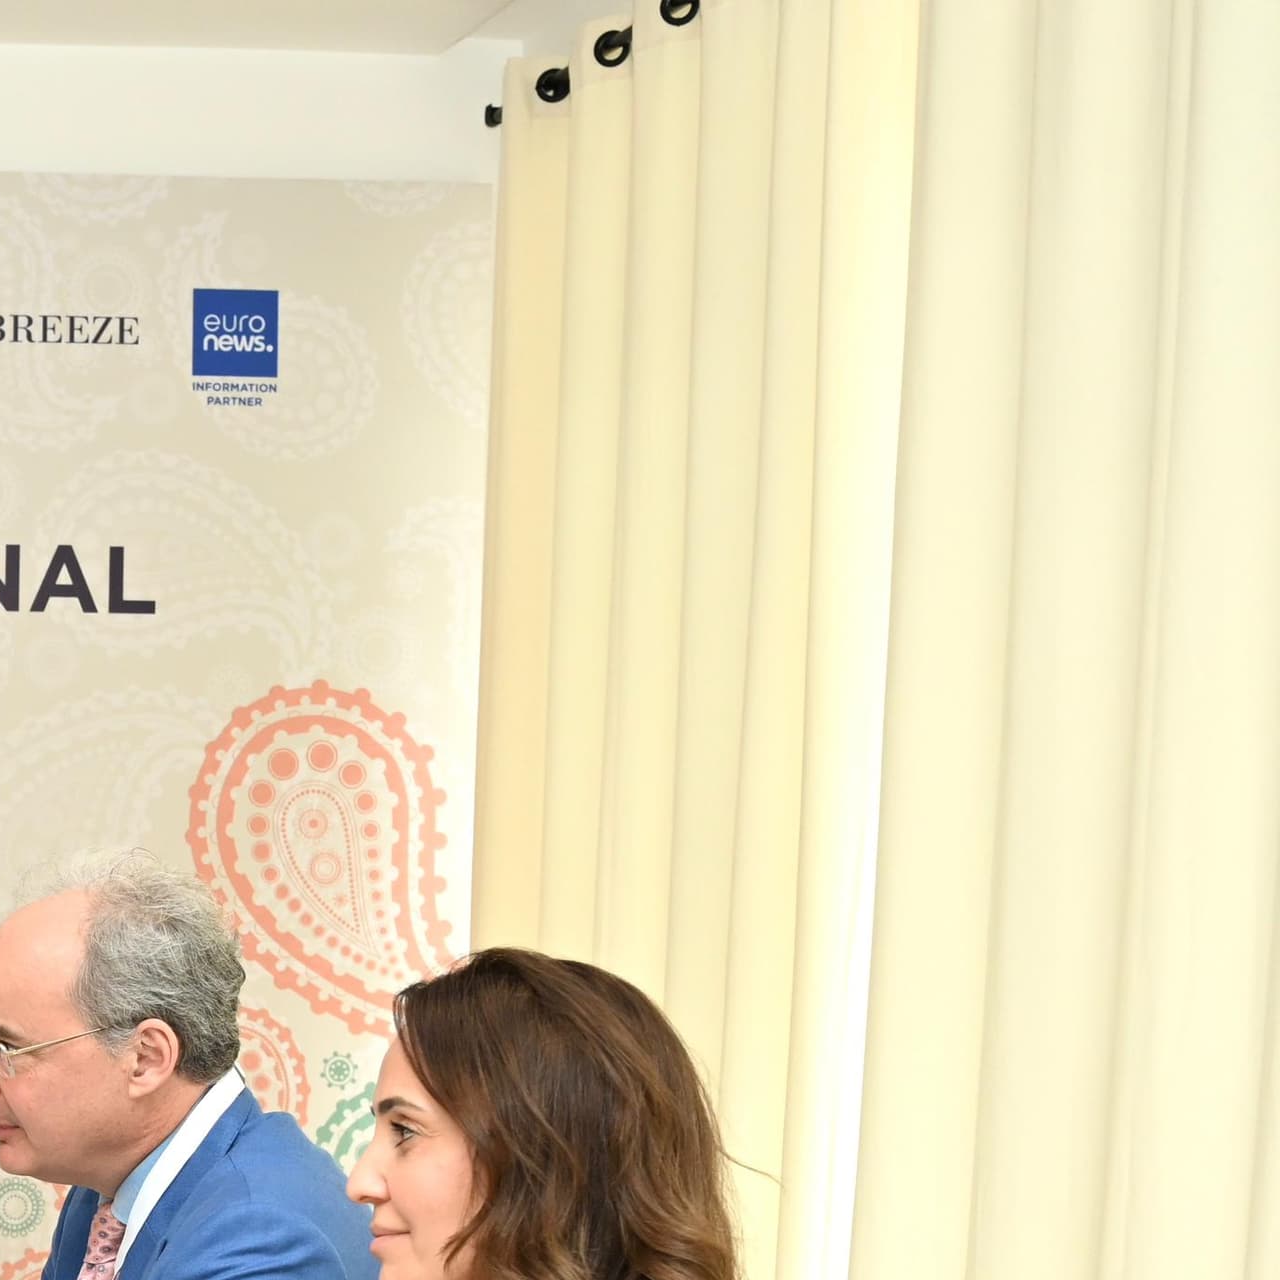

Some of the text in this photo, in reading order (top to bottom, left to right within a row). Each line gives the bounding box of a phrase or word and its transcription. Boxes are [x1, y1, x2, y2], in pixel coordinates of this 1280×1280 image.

[203, 313, 266, 333] euro
[203, 333, 274, 353] news.
[192, 382, 278, 393] INFORMATION
[207, 396, 263, 407] PARTNER
